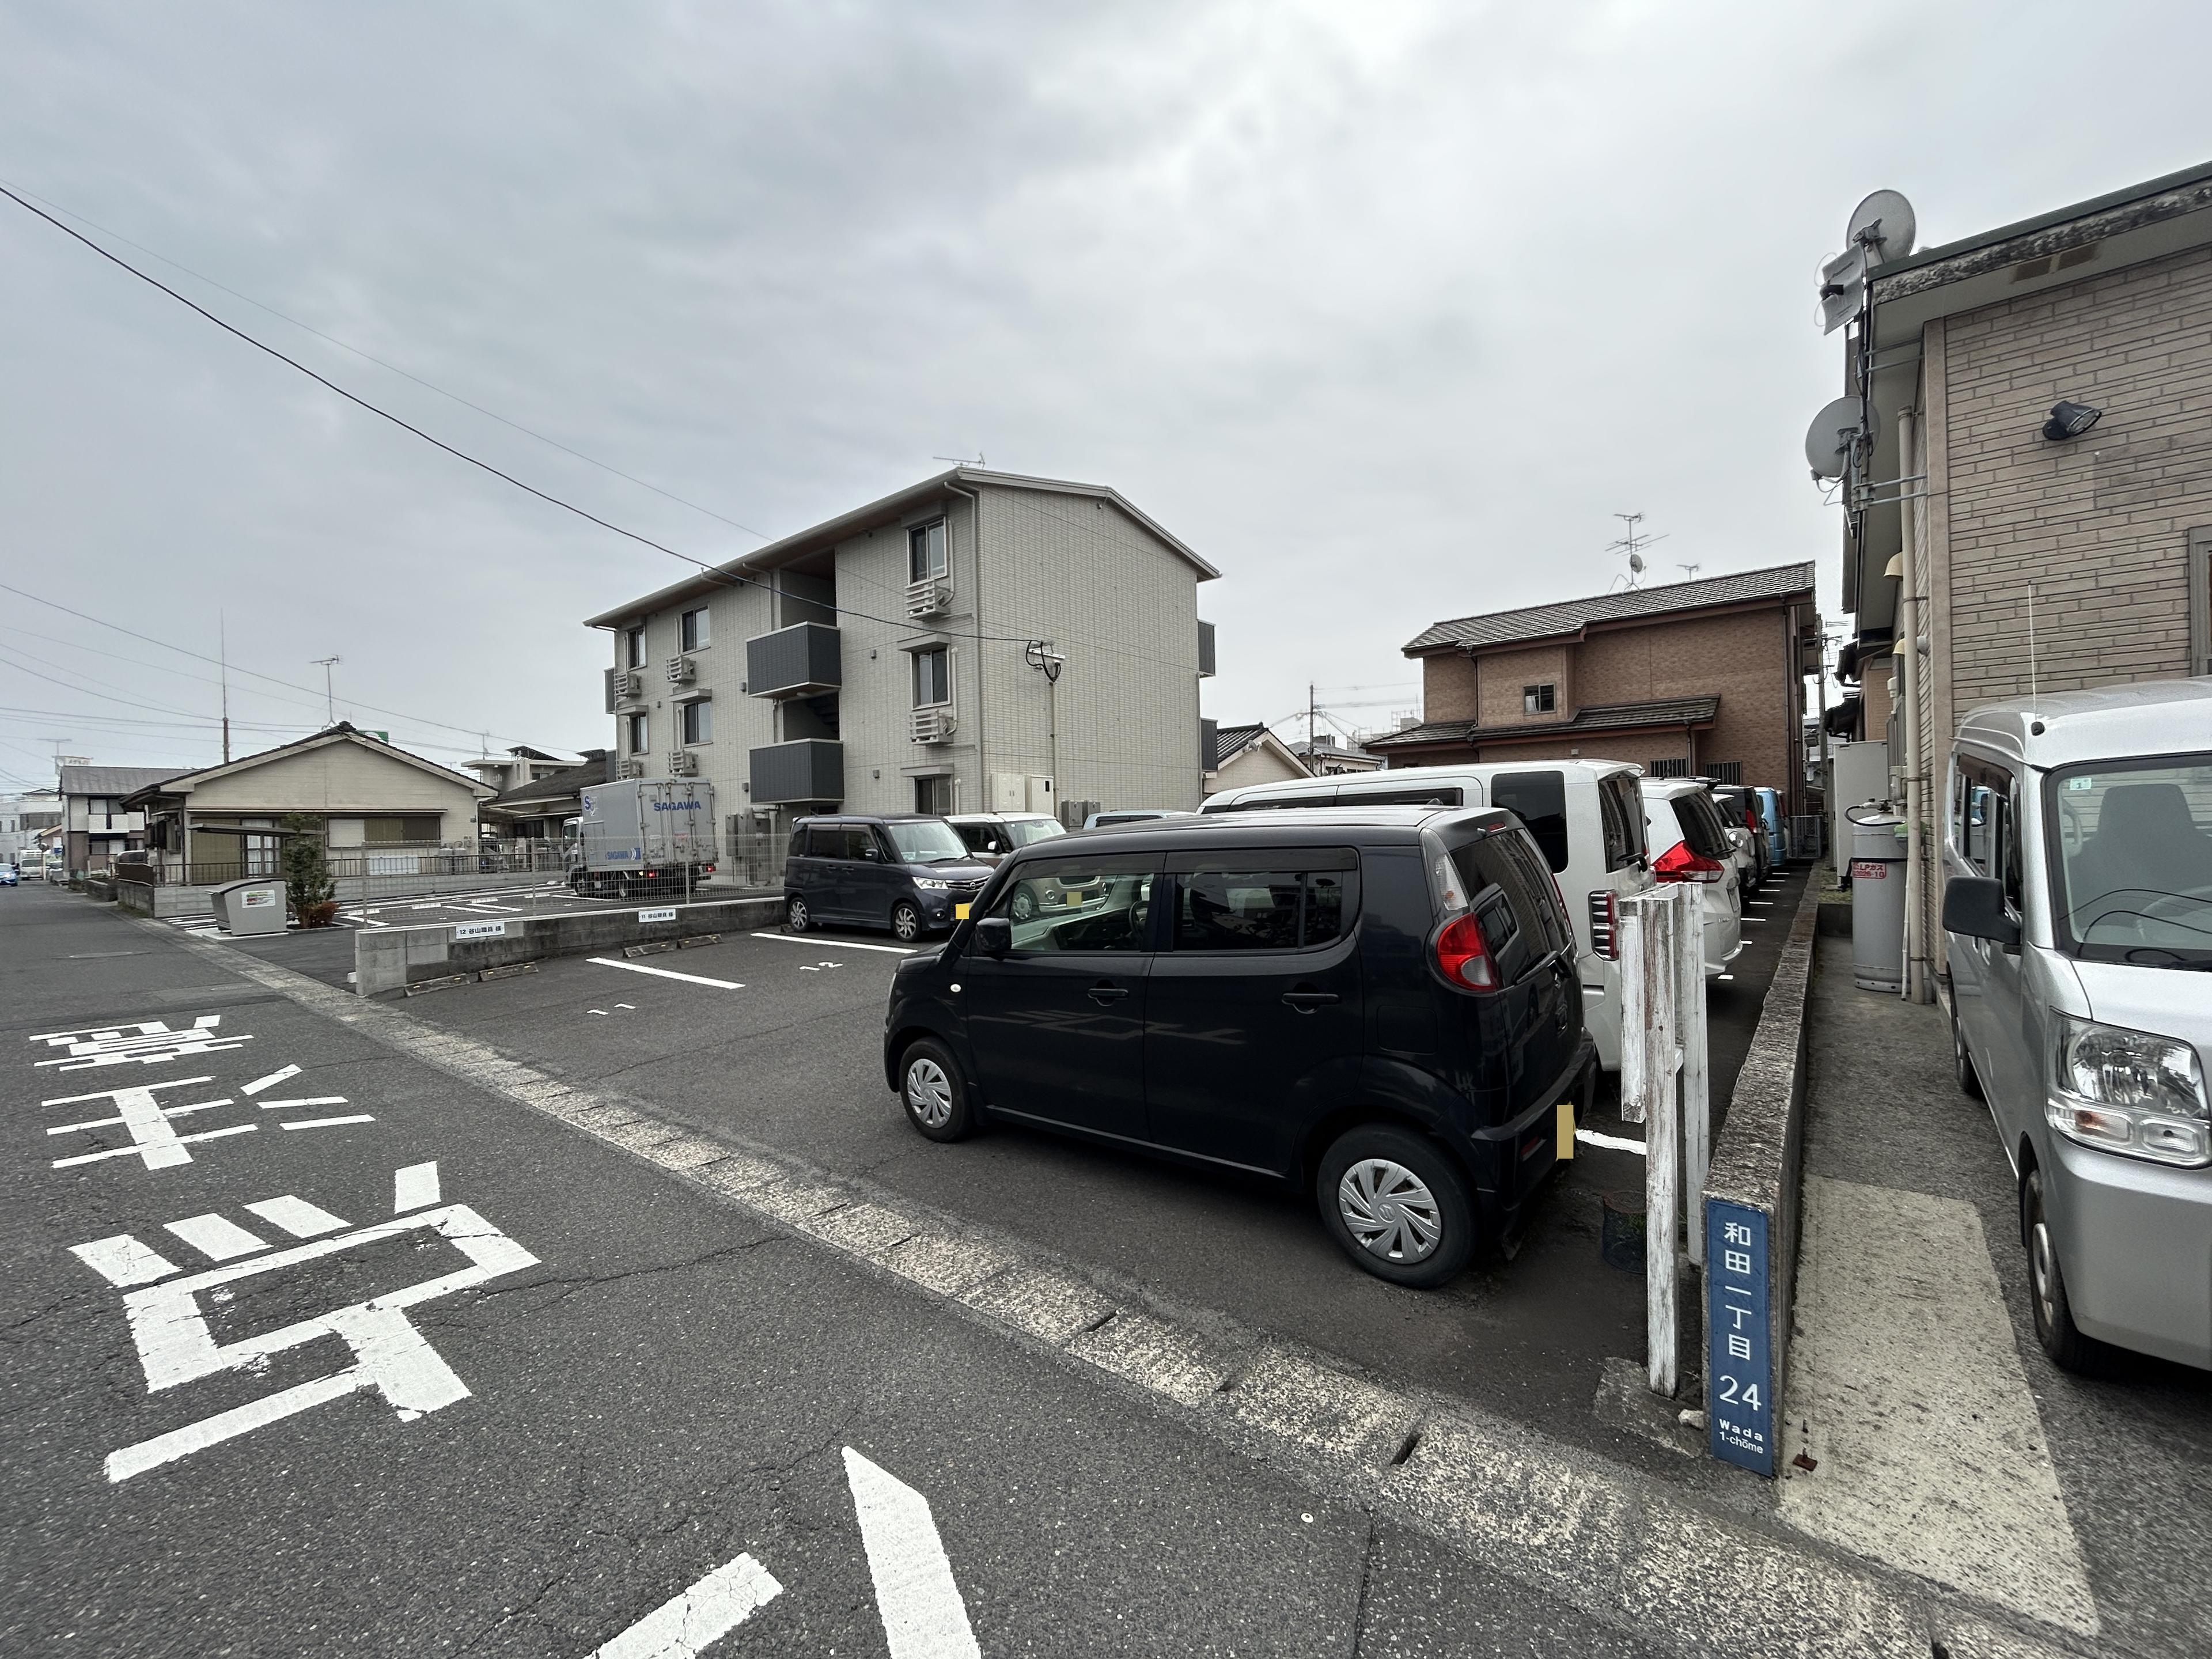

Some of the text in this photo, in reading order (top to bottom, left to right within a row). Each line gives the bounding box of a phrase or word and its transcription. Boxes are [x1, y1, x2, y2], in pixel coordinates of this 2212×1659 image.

[653, 801, 702, 812] SAGAWA
[607, 850, 629, 860] SAGAWA
[1724, 1221, 1752, 1361] 和田一丁目
[1718, 1374, 1762, 1411] 24
[1718, 1418, 1763, 1442] Wada
[1719, 1431, 1764, 1454] 1-chōme
